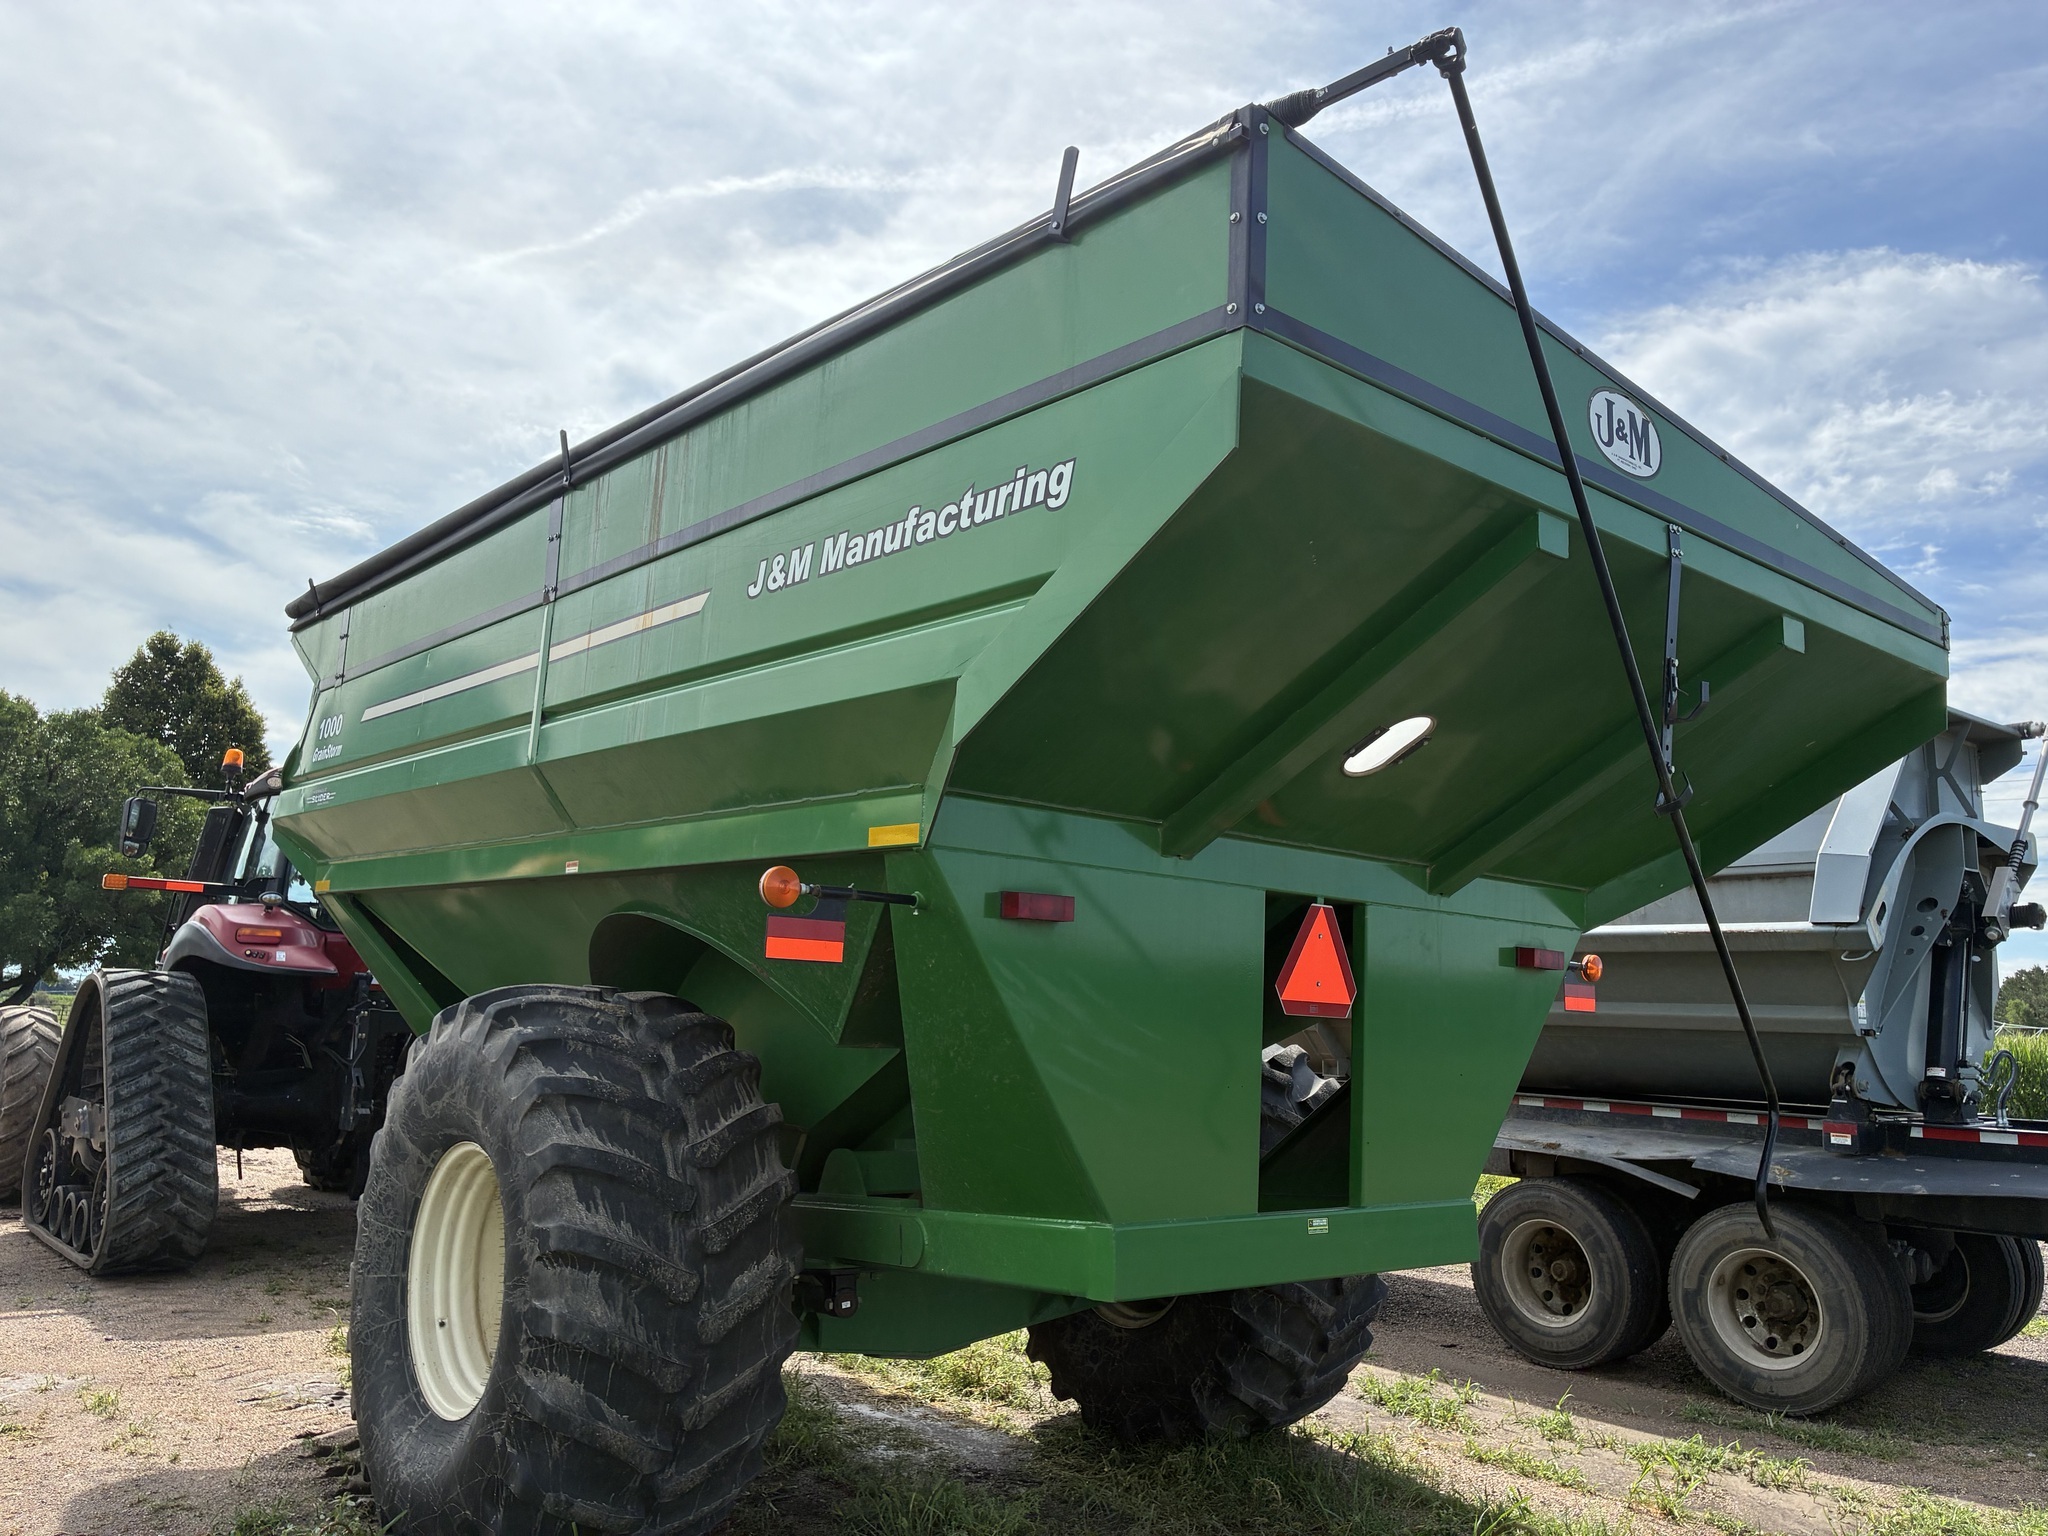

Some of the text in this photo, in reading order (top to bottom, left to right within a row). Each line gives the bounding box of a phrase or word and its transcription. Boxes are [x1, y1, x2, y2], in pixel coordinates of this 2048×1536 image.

[1595, 397, 1653, 468] J&M
[747, 457, 1077, 599] J&M Manufacturing
[319, 713, 343, 740] 1000
